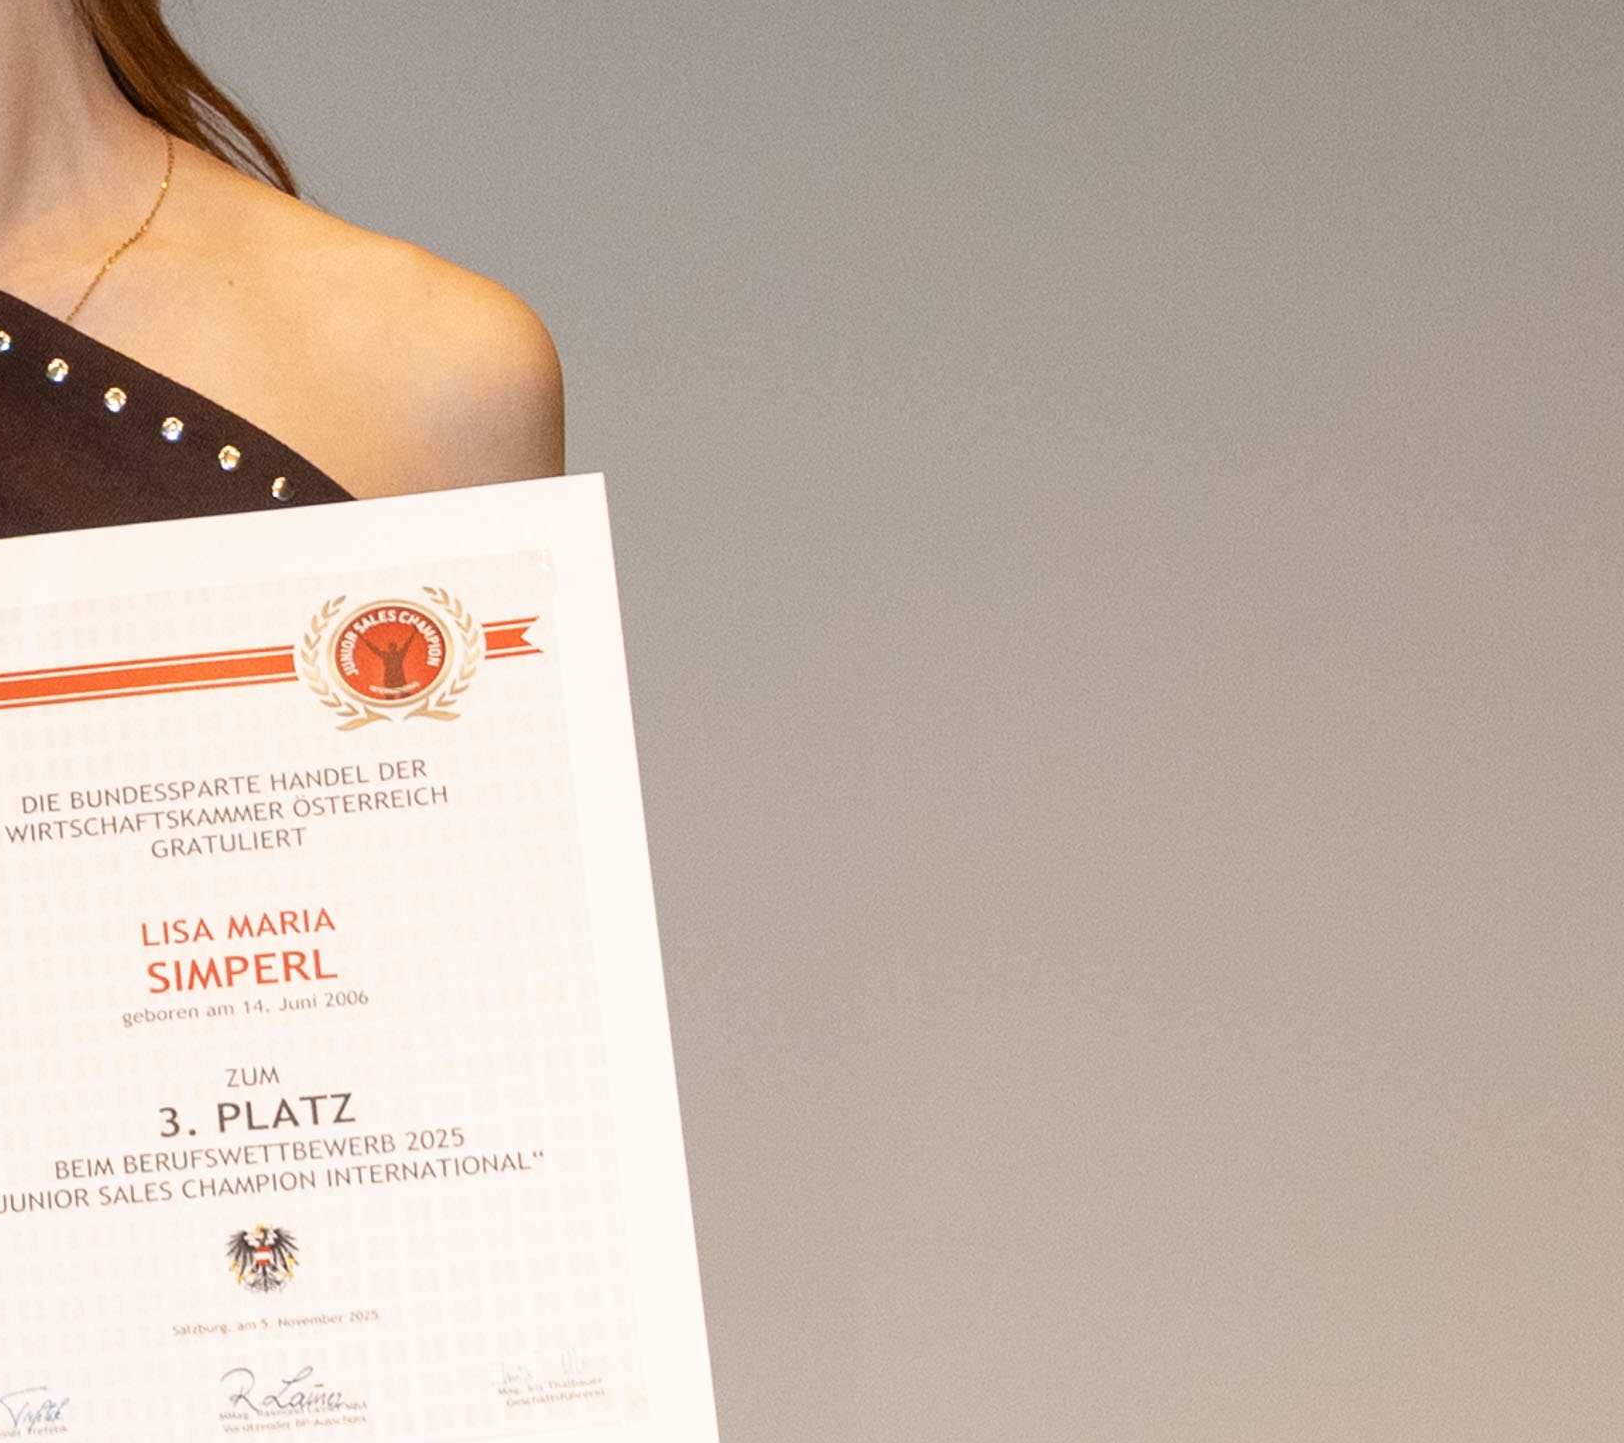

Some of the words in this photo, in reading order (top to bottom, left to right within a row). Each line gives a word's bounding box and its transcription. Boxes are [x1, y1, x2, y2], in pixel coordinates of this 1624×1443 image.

[340, 631, 359, 676] JUNIOR
[353, 609, 397, 634] SALES
[398, 611, 443, 668] CHAMPION
[22, 792, 60, 815] DIE
[70, 775, 261, 811] BUNDESSPARTE
[270, 765, 369, 792] HANDEL
[379, 759, 426, 782] DER
[5, 801, 284, 844] WIRTSCHAFTSKAMMER
[293, 786, 448, 818] ÖSTERREICH
[151, 827, 306, 859] GRATULIERT
[141, 917, 214, 947] LISA
[227, 907, 336, 939] MARIA
[147, 948, 338, 995] SIMPERL
[122, 1007, 199, 1029] geboren
[206, 1004, 235, 1018] am
[244, 998, 270, 1014] 14.
[279, 996, 317, 1012] Juni
[325, 989, 369, 1009] 2006
[226, 1066, 280, 1089] ZUM
[159, 1107, 196, 1138] 3.
[217, 1092, 355, 1133] PLATZ
[55, 1157, 114, 1180] BEIM
[123, 1133, 395, 1175] BERUFSWETTBEWERB
[406, 1127, 464, 1152] 2025
[99, 1181, 172, 1206] SALES
[182, 1170, 316, 1200] CHAMPION
